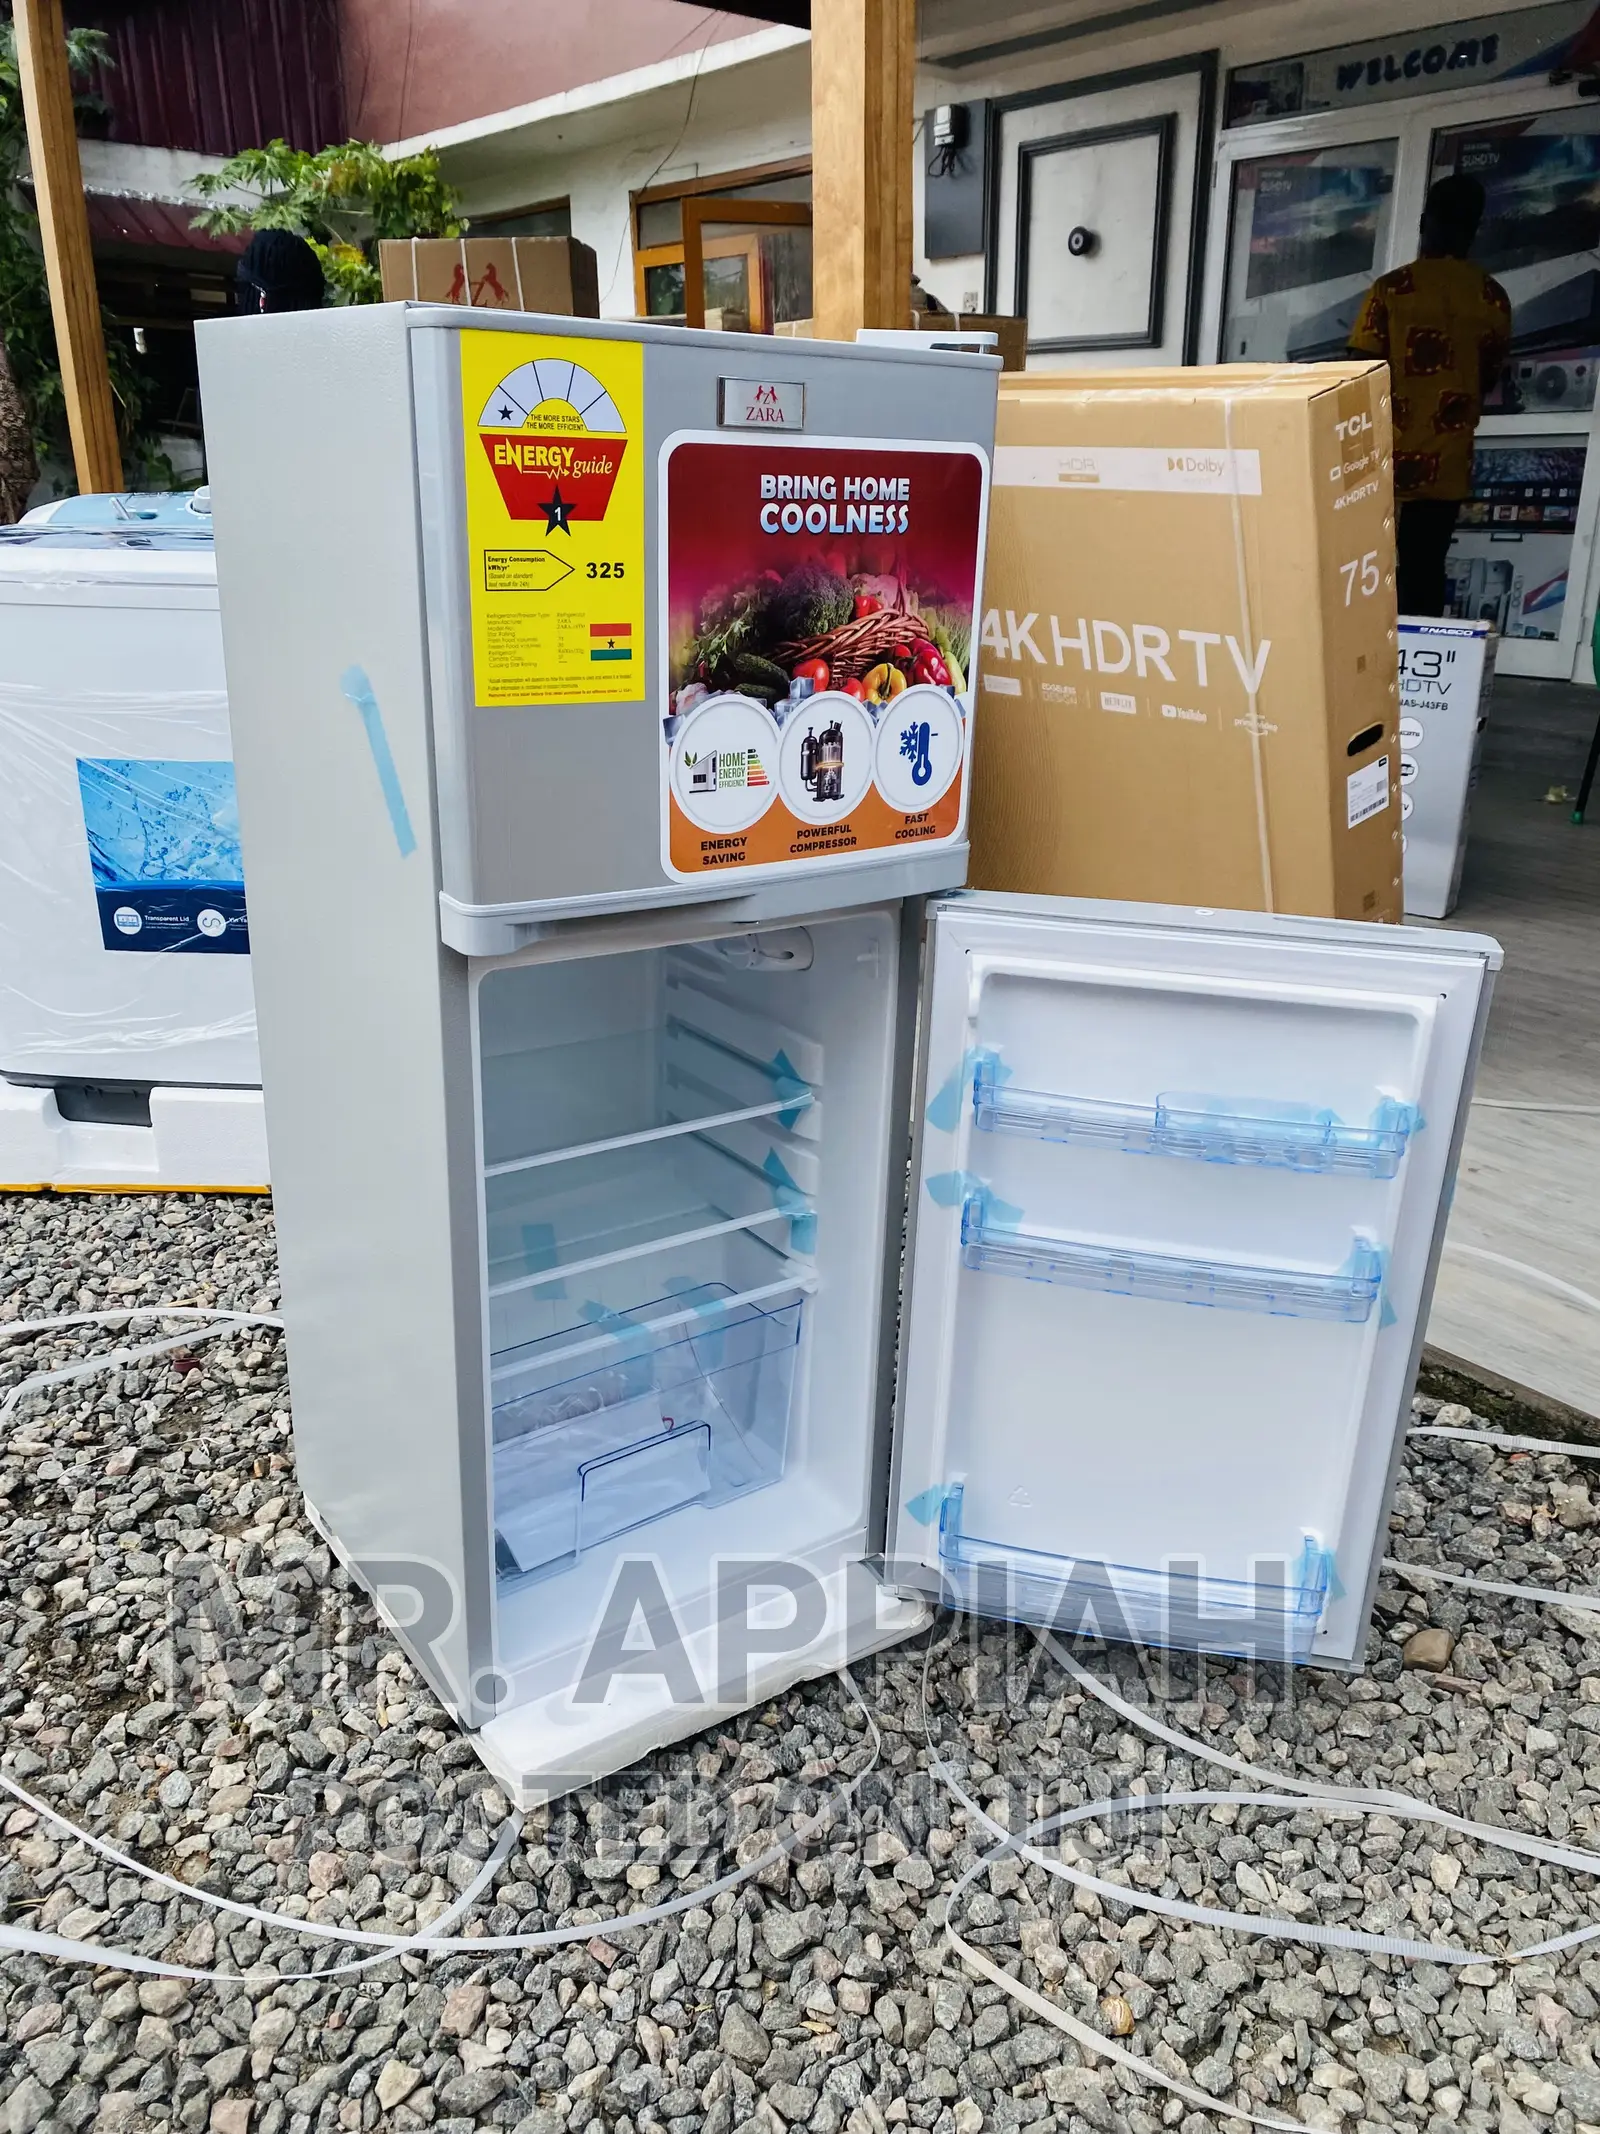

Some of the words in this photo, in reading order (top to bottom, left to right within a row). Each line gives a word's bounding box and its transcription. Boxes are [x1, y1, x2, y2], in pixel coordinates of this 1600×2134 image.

[1336, 33, 1499, 92] WELCOME
[531, 413, 543, 421] THE
[544, 414, 560, 422] MORE
[562, 415, 580, 423] STARS
[746, 406, 785, 422] ZARA
[526, 421, 538, 429] THE
[538, 422, 555, 430] MORE
[557, 423, 584, 431] EFFICIENT
[1335, 412, 1373, 442] TCL
[494, 437, 574, 474] ENERGY
[572, 455, 613, 478] guide
[1343, 455, 1369, 475] Google
[1370, 447, 1381, 464] TV
[1186, 456, 1225, 476] Dolby
[760, 474, 837, 500] BRING
[843, 477, 910, 501] HOME
[554, 506, 561, 521] 1
[760, 502, 909, 534] COOLNESS
[586, 562, 625, 579] 325
[1340, 549, 1380, 607] 75
[1428, 627, 1474, 636] NASCO
[719, 752, 746, 768] HOME
[719, 767, 746, 779] ENERGY
[719, 780, 746, 789] EFFICIENCY
[904, 813, 929, 825] FAST
[797, 824, 852, 839] POWERFUL
[895, 825, 936, 839] COOLING
[700, 837, 748, 851] ENERGY
[790, 837, 858, 854] COMPRESSOR
[703, 852, 746, 866] SAVING
